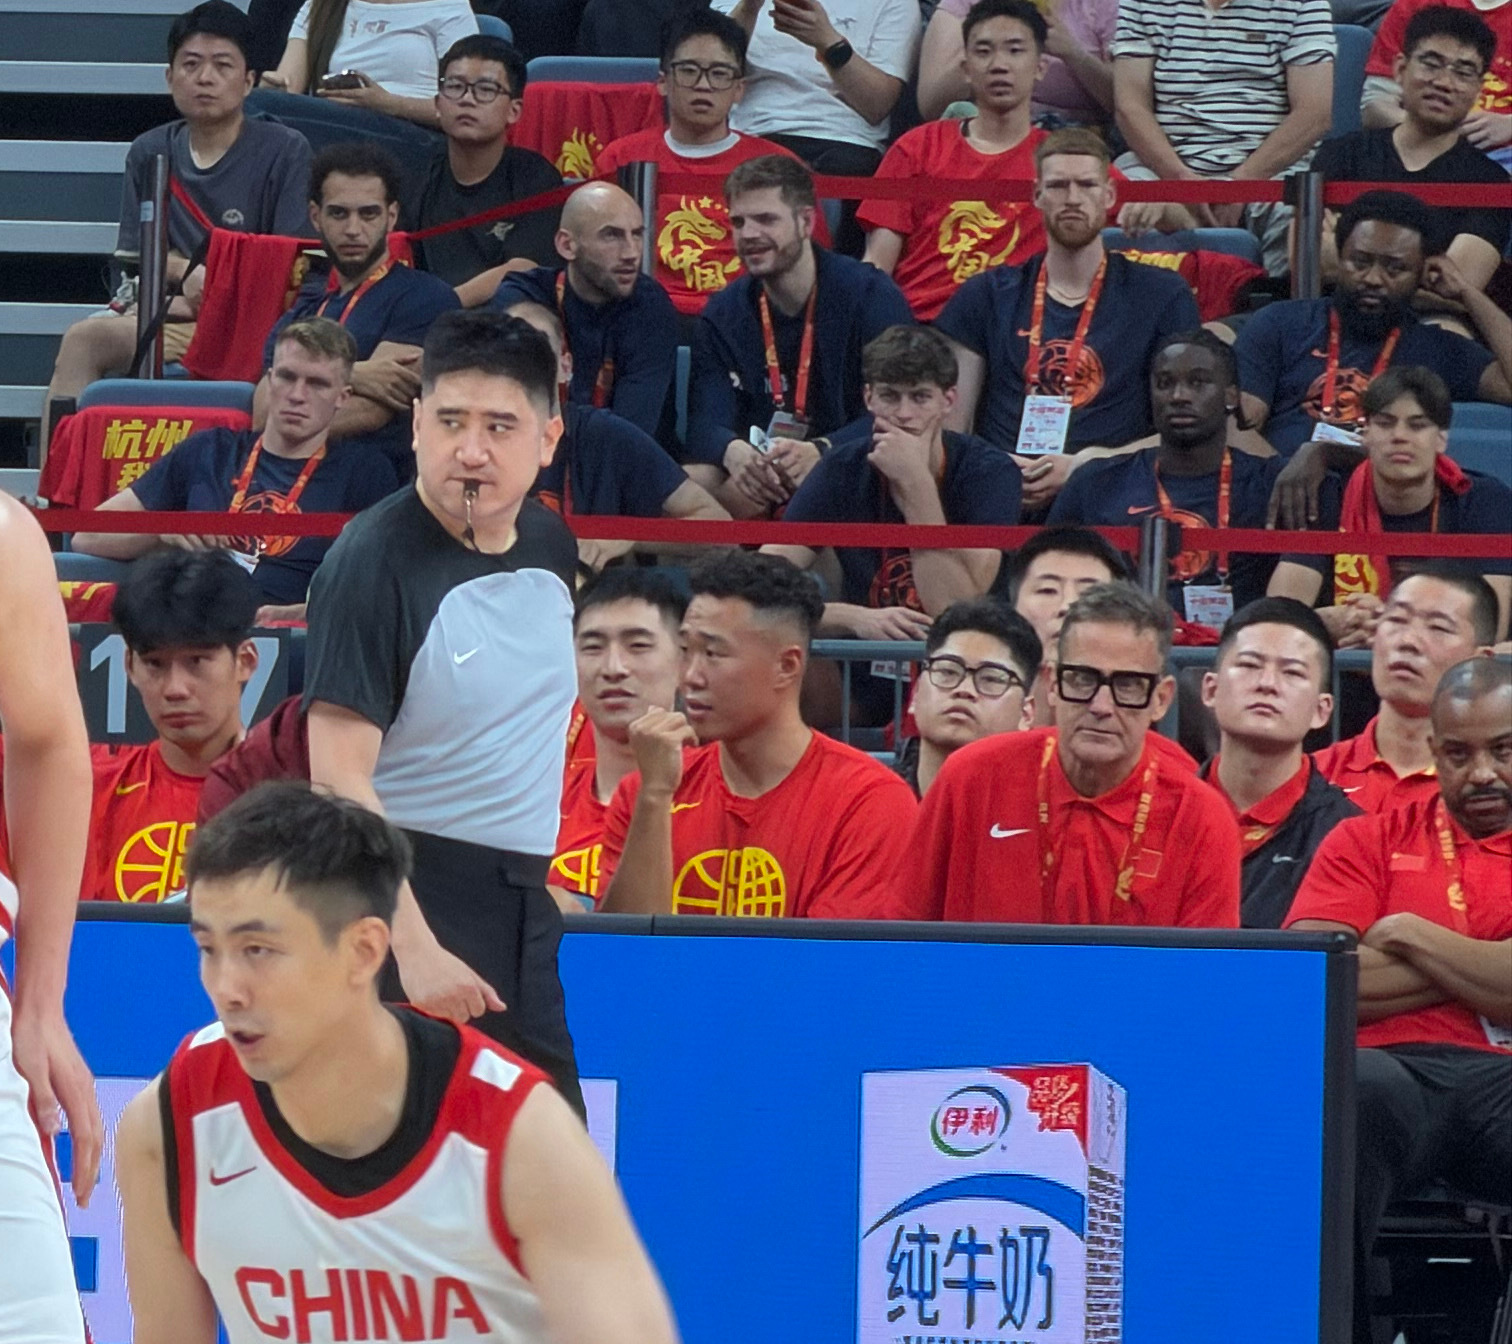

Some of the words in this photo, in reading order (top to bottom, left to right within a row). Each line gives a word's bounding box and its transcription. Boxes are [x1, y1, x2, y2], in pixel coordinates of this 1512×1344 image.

[668, 245, 728, 292] 中国
[90, 634, 280, 733] 17
[941, 1105, 999, 1137] 伊利
[886, 1222, 1054, 1332] 纯牛奶
